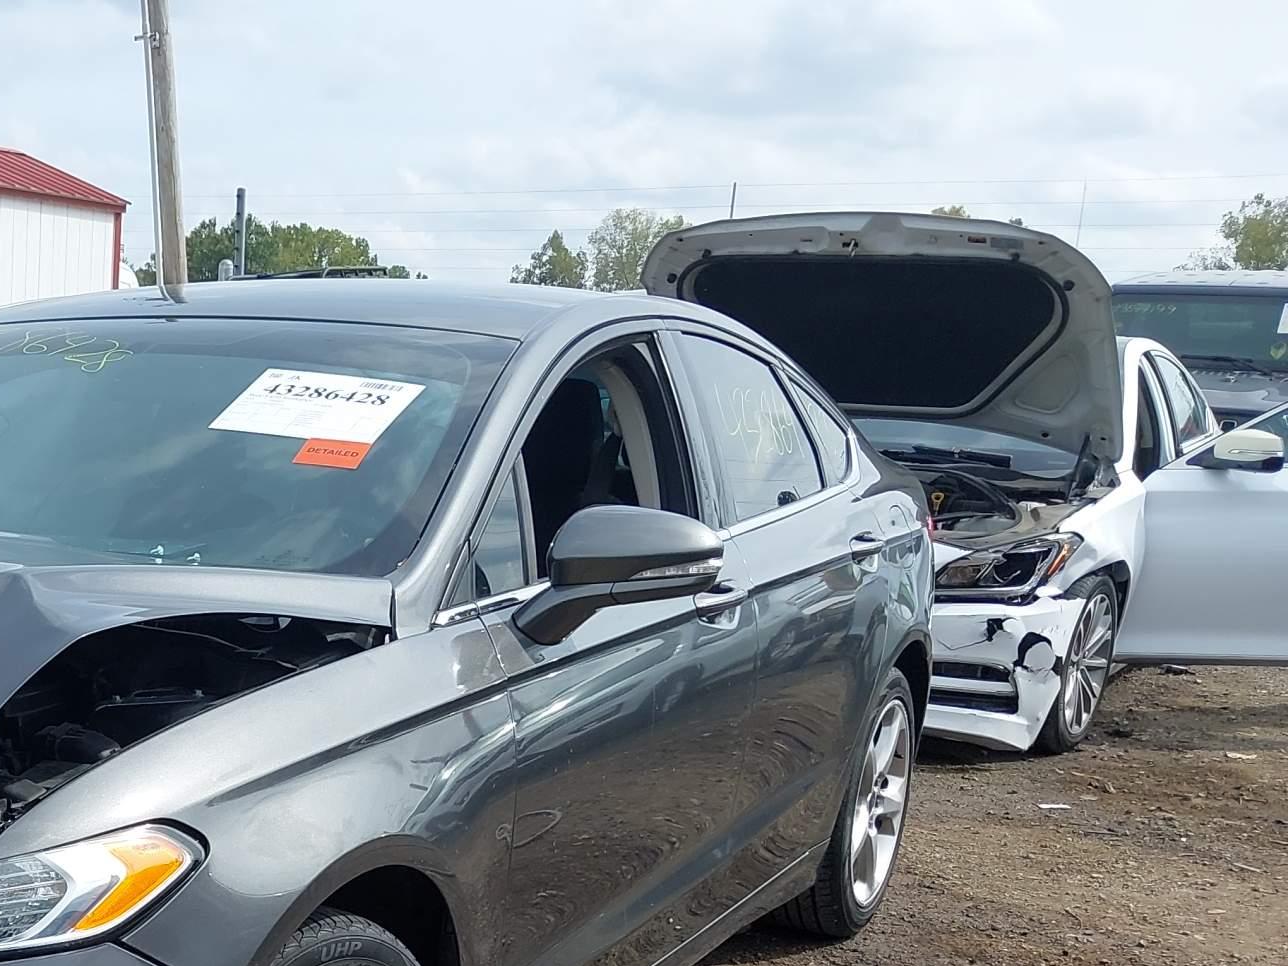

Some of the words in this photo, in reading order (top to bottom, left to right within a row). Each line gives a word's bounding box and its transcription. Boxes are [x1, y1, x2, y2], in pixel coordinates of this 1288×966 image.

[264, 383, 391, 406] 43286428
[306, 447, 359, 458] DETAILED
[320, 941, 363, 962] UHP
